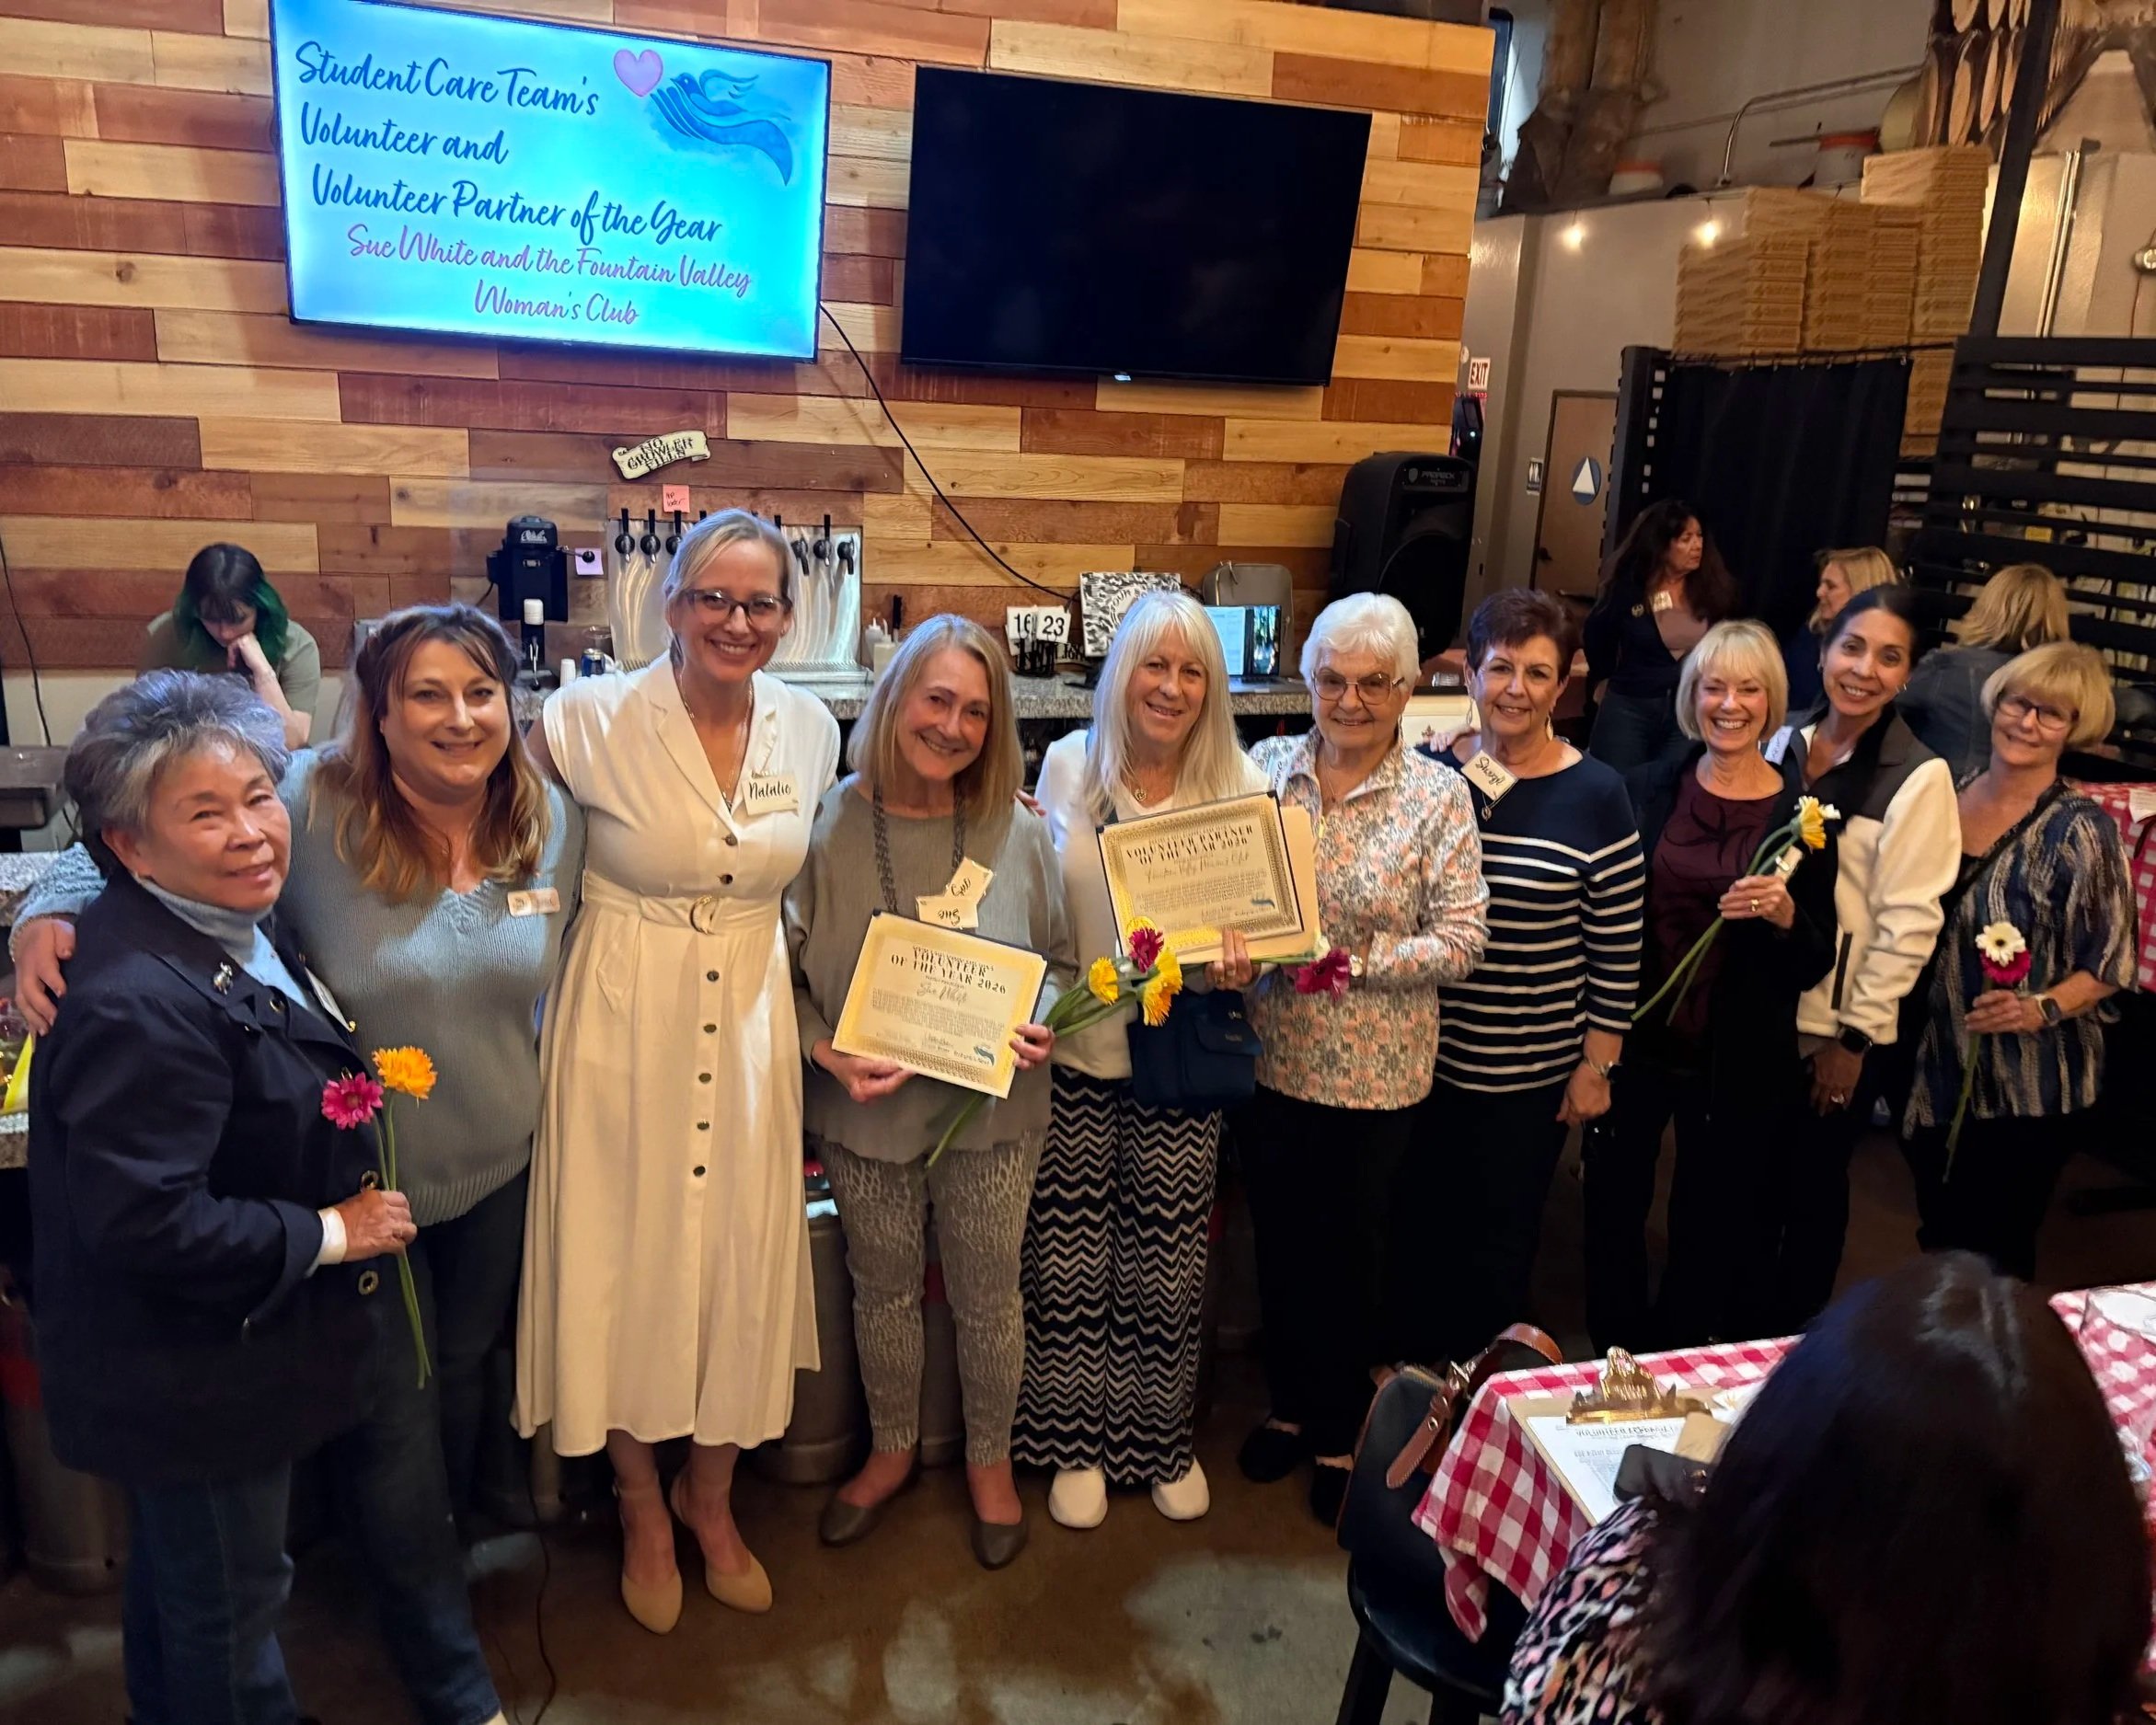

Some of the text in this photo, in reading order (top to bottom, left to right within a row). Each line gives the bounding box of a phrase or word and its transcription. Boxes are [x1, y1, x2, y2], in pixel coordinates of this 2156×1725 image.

[295, 40, 599, 116] Student Care Team's
[301, 101, 509, 165] Volunteer and
[313, 163, 722, 246] Volunteer Partner of the Year
[347, 224, 751, 298] Sue White and the Fountain Valley
[474, 279, 640, 325] Woman's Club
[1470, 362, 1488, 385] EXIT
[1042, 615, 1065, 637] 23
[749, 780, 791, 800] Natalie
[1126, 836, 1195, 859] VOLUNTEER
[1199, 824, 1252, 844] PARTNER
[1186, 841, 1216, 856] YEAR
[937, 908, 961, 926] Sue
[891, 954, 907, 966] OF
[914, 960, 936, 974] THE
[941, 967, 973, 985] YEAR
[914, 949, 986, 978] VOLUNTEER
